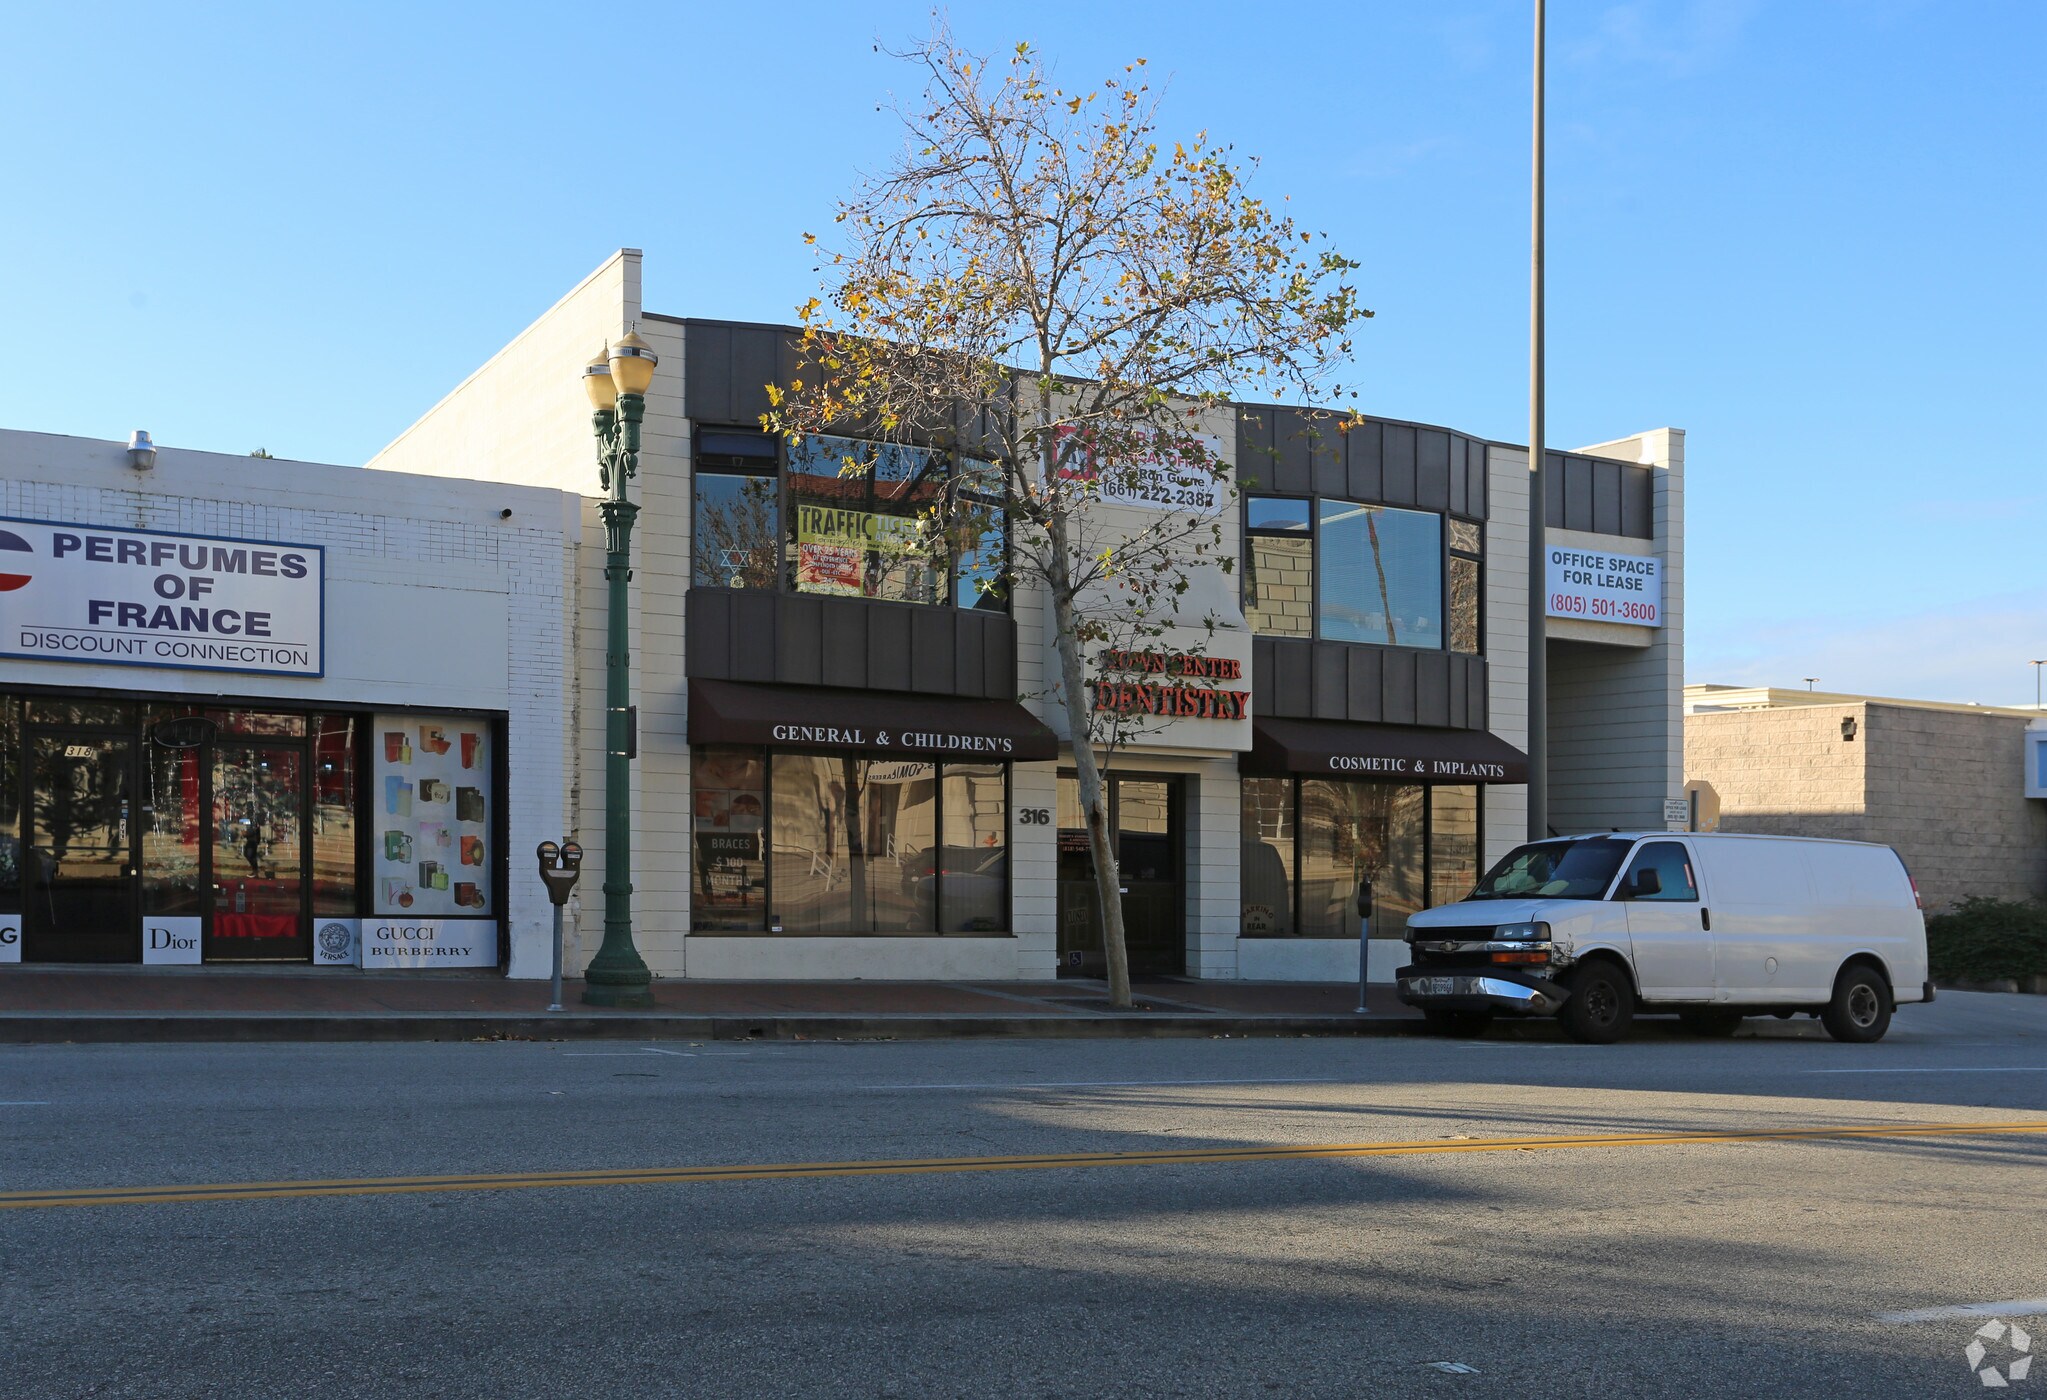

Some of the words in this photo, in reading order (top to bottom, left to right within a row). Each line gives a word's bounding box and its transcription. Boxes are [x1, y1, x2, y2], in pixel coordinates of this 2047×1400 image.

[1140, 468, 1163, 482] Ron
[800, 506, 872, 541] TRAFFIC
[53, 532, 308, 579] PERFUMES
[1551, 551, 1605, 569] OFFICE
[1608, 558, 1654, 576] SPACE
[153, 573, 214, 601] OF
[1563, 570, 1593, 585] FOR
[1597, 574, 1643, 591] LEASE
[1550, 593, 1587, 614] (805)
[1592, 598, 1656, 621] 501-3600
[88, 600, 272, 637] FRANCE
[20, 632, 148, 654] DISCOUNT
[154, 641, 308, 665] CONNECTION
[1096, 681, 1251, 720] DENTISTRY
[772, 725, 866, 744] GENERAL
[876, 731, 890, 745] &
[901, 732, 1012, 752] CHILDREN'S
[67, 746, 91, 756] 318
[1329, 756, 1406, 772] COSMETIC
[1414, 760, 1425, 772] &
[1433, 761, 1504, 777] IMPLANTS
[1020, 808, 1050, 825] 316
[712, 838, 750, 849] BRACES
[706, 875, 752, 886] MONTHLY
[1242, 905, 1274, 919] PARKING
[376, 927, 434, 940] GUCCI
[1246, 922, 1267, 930] REAR
[148, 928, 197, 950] Dior
[319, 950, 350, 961] VERSACE
[372, 947, 473, 956] BURBERRY
